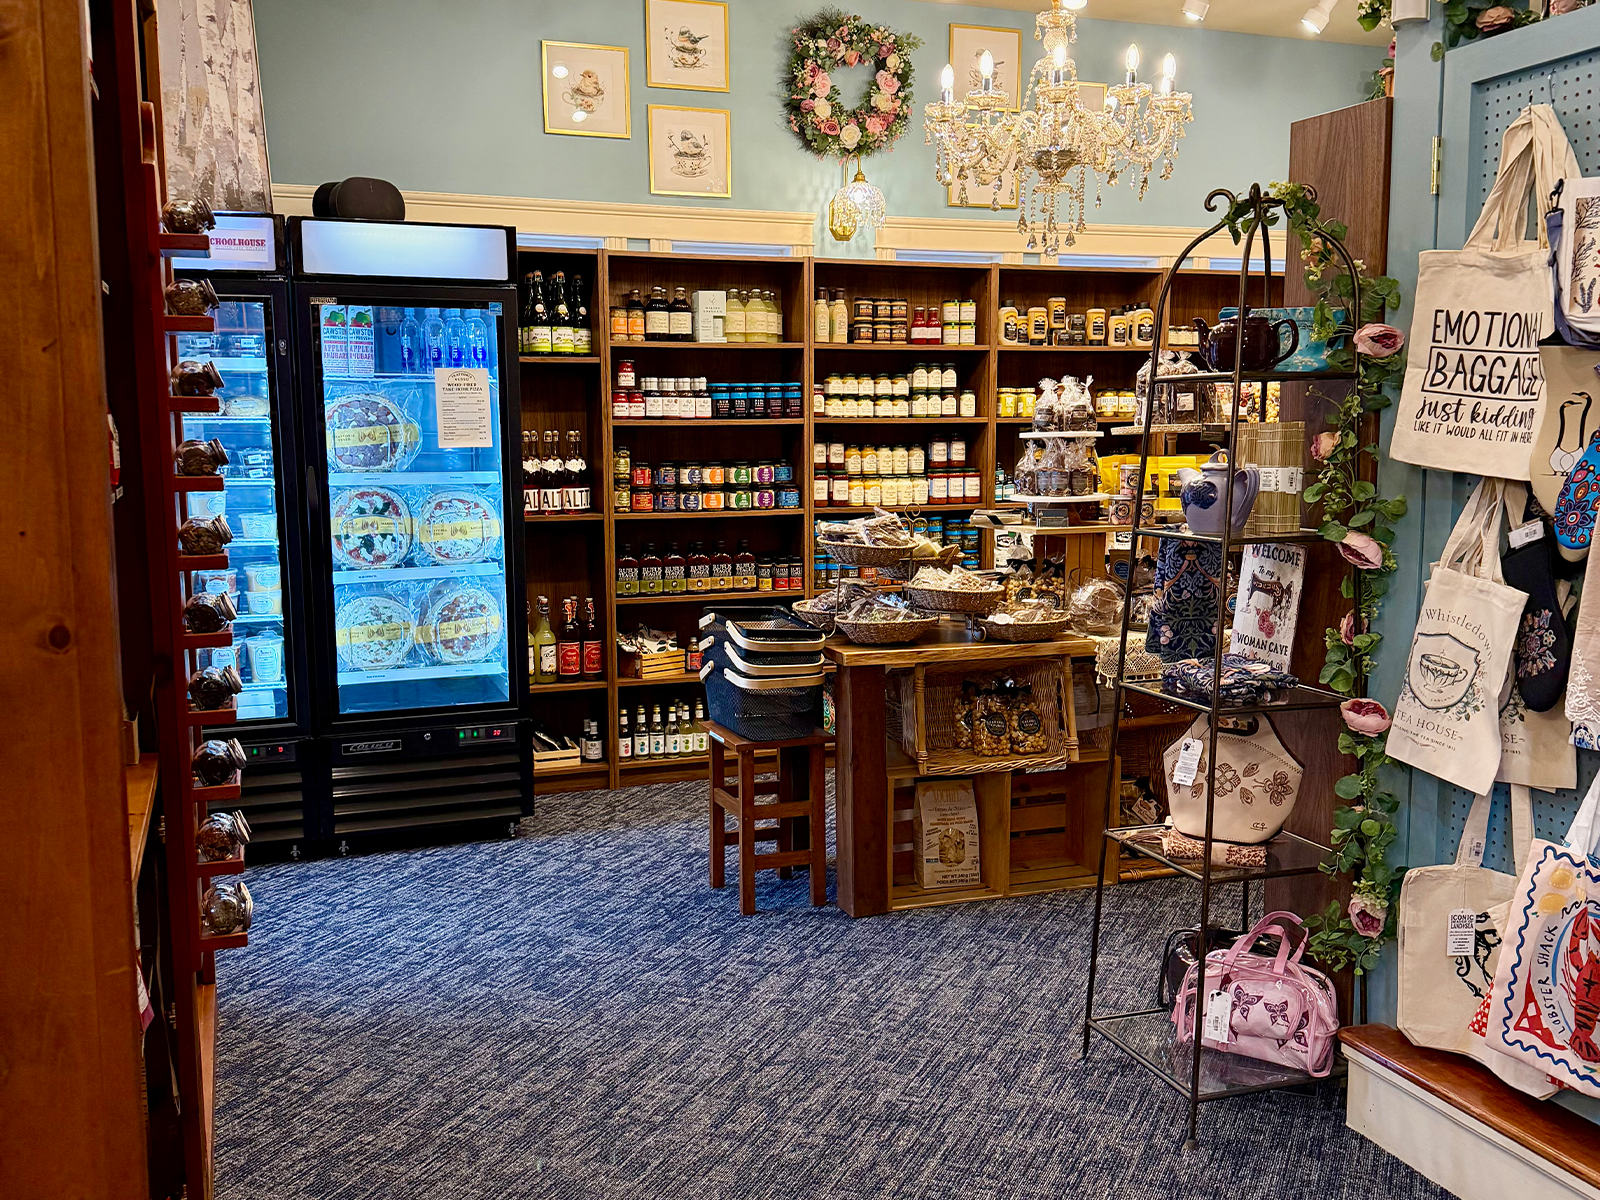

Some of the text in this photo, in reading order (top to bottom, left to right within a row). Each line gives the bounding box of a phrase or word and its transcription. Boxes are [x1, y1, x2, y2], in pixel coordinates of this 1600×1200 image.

[210, 238, 266, 246] CHOOLHOUSE
[1429, 352, 1538, 396] BAGGAGE
[1416, 396, 1537, 430] just kidding
[1414, 420, 1533, 444] LIKE IT WOULD ALL FIT IN HERE
[1251, 544, 1301, 567] WELCOME
[1237, 632, 1289, 656] WOMAN CAVE
[1425, 608, 1492, 661] Whistledown
[1396, 709, 1458, 740] TEA HOUSE
[1537, 925, 1565, 1035] LOBSTER SHACK
